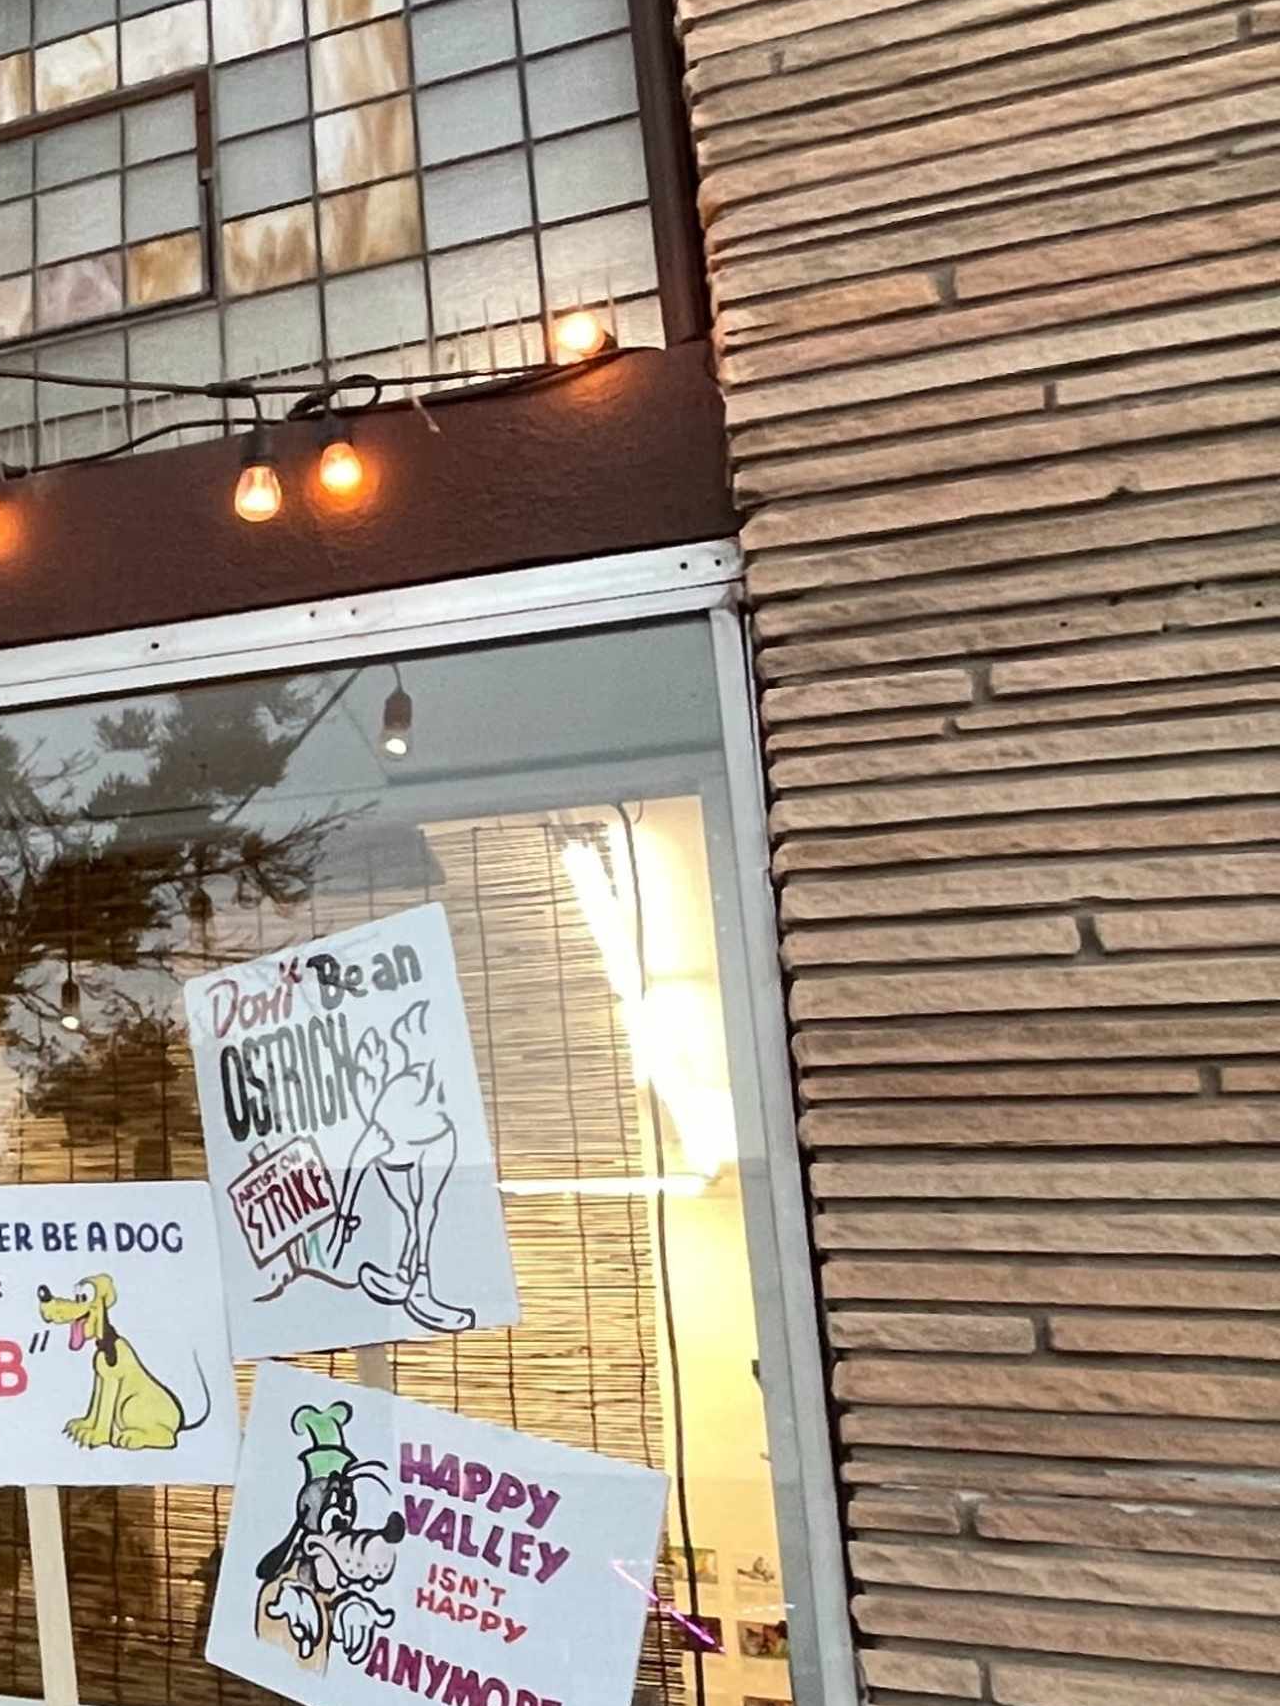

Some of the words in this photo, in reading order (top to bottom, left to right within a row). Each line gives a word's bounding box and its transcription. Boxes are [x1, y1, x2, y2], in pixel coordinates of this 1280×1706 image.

[306, 953, 369, 1011] Be
[372, 944, 423, 990] an
[220, 1013, 352, 1142] OSTRICH
[42, 1221, 78, 1252] BE
[87, 1221, 108, 1252] A
[115, 1221, 184, 1253] DOG
[245, 1167, 331, 1250] STRIKE
[400, 1442, 561, 1529] HAPPY
[404, 1494, 570, 1583] VALLEY
[415, 1587, 527, 1644] HAPPY
[427, 1563, 506, 1607] ISN'T
